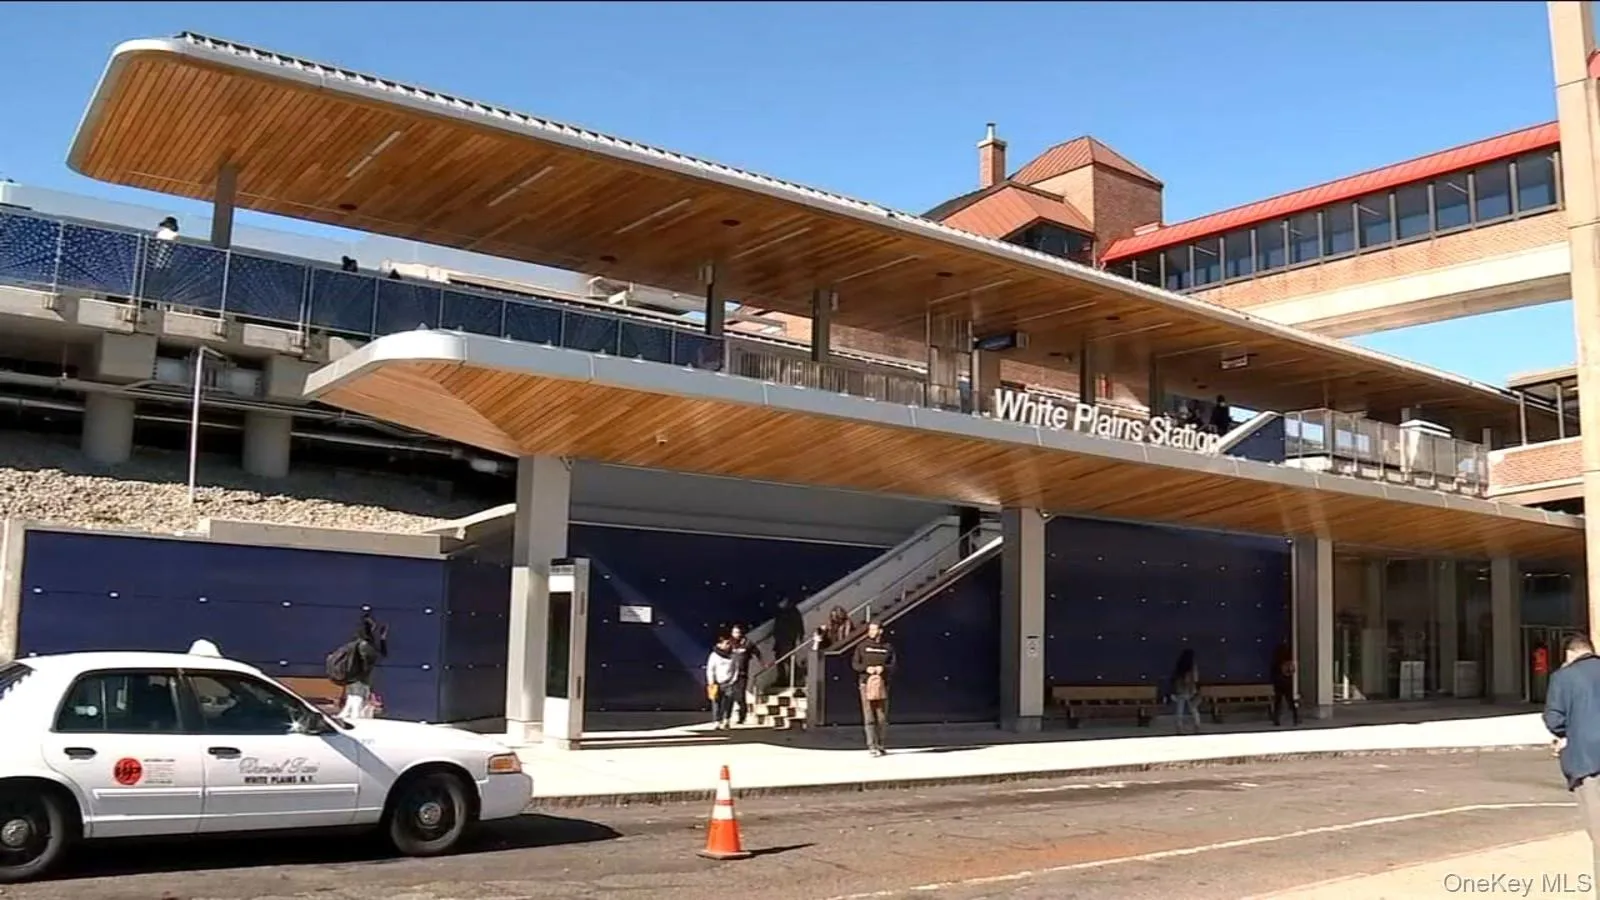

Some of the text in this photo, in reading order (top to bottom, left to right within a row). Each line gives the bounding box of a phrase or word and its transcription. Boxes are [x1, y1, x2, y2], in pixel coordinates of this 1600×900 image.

[995, 388, 1221, 454] White Plains Station
[244, 775, 268, 784] WHITE
[271, 775, 297, 784] PLAINS
